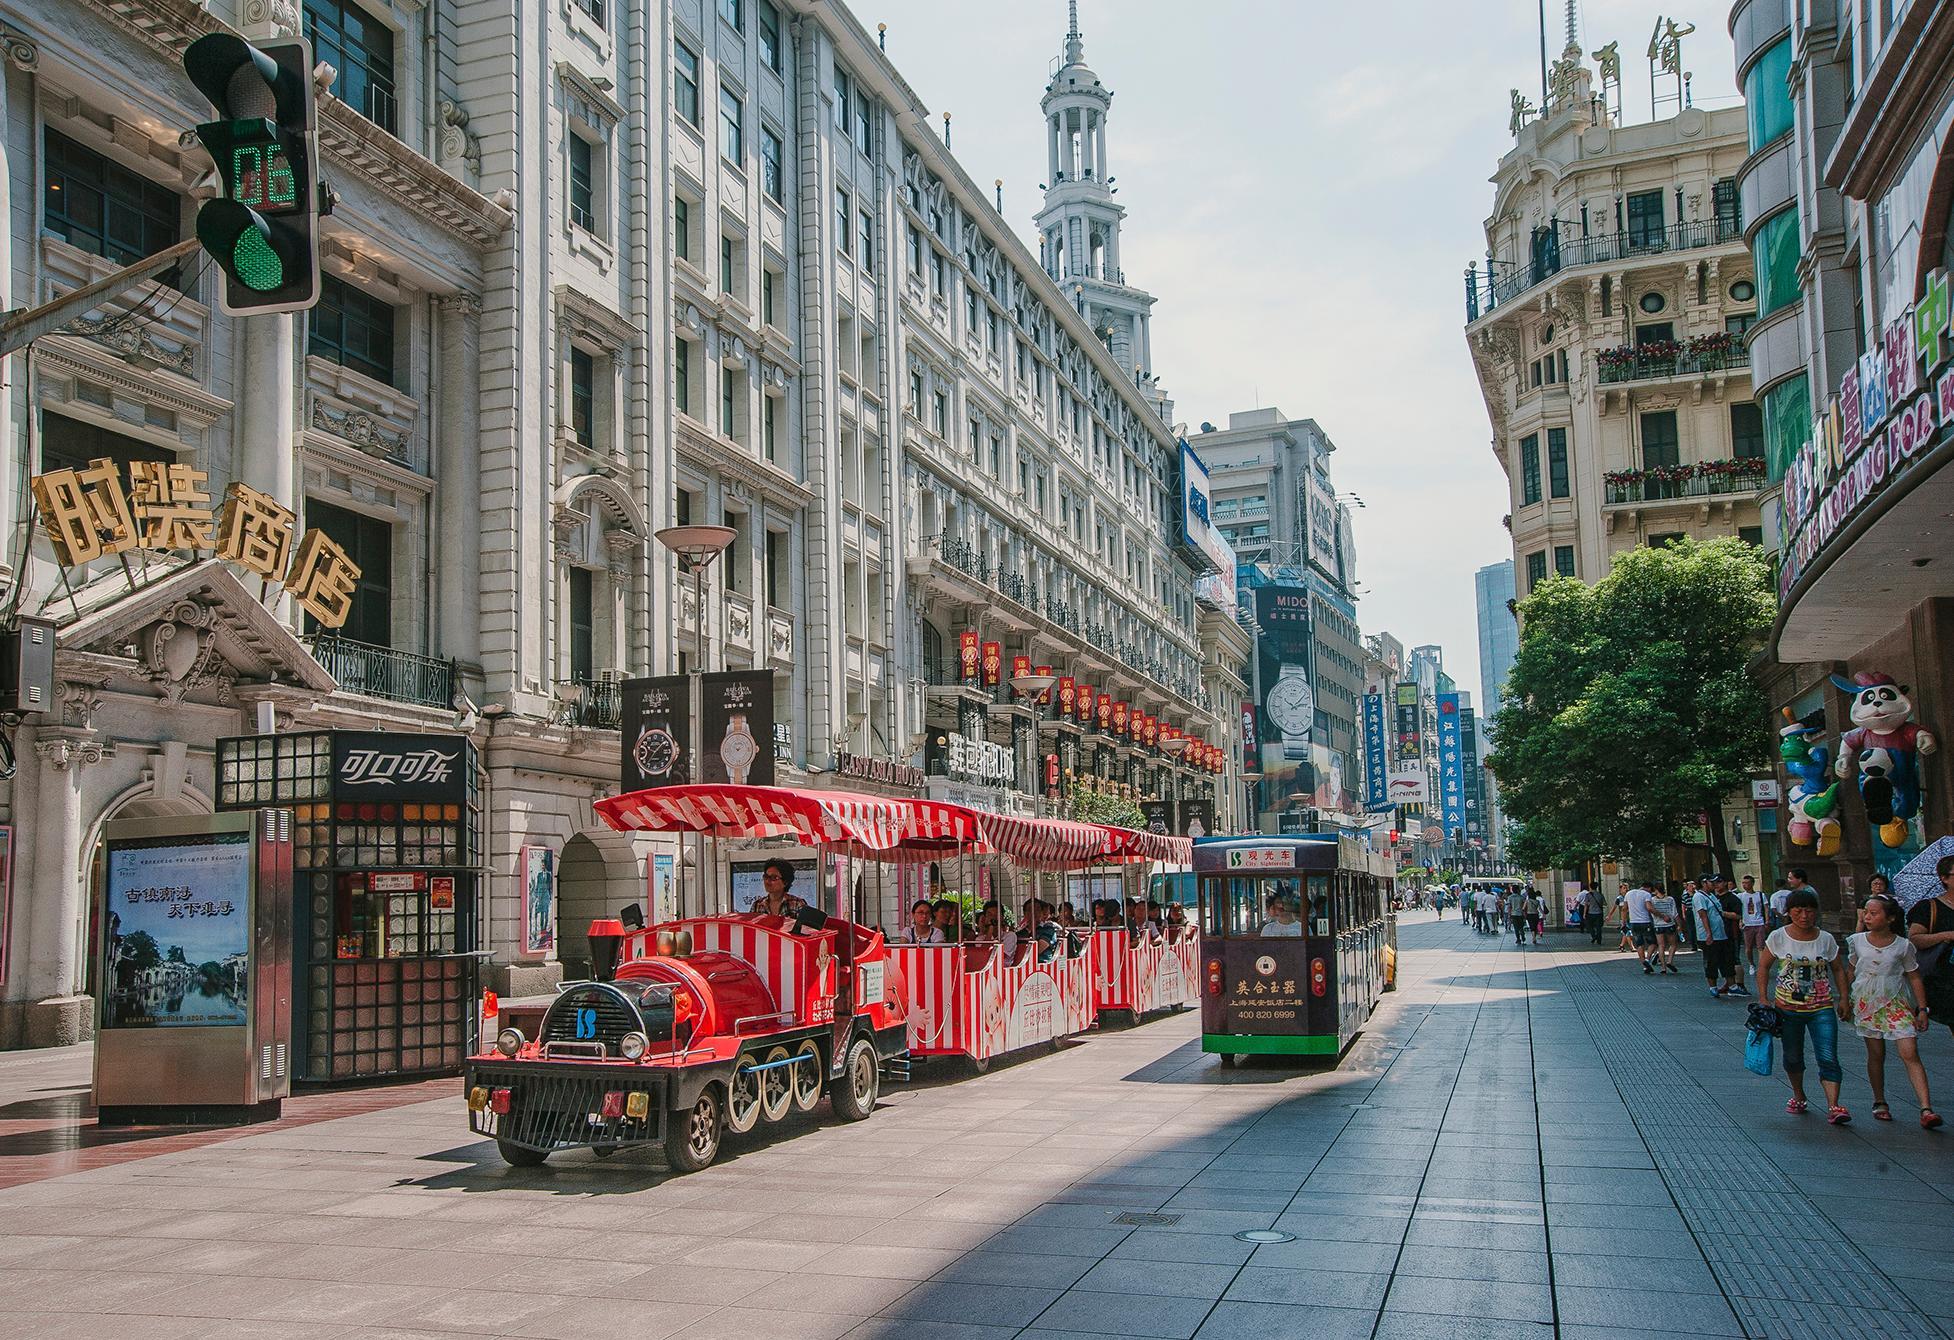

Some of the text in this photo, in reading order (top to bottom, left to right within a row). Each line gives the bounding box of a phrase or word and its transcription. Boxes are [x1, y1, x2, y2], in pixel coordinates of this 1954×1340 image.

[1888, 390, 1936, 475] FOR
[31, 458, 362, 629] 时装商店
[1277, 595, 1308, 607] MIDO
[340, 749, 459, 785] 可口可乐
[841, 752, 925, 788] EAST ASIA HOTEL
[1248, 850, 1291, 861] 观光车
[125, 885, 193, 903] 古镇南浔
[168, 900, 235, 919] 天下难寻
[1319, 920, 1328, 934] 10
[1238, 1010, 1295, 1019] 400 820 6999
